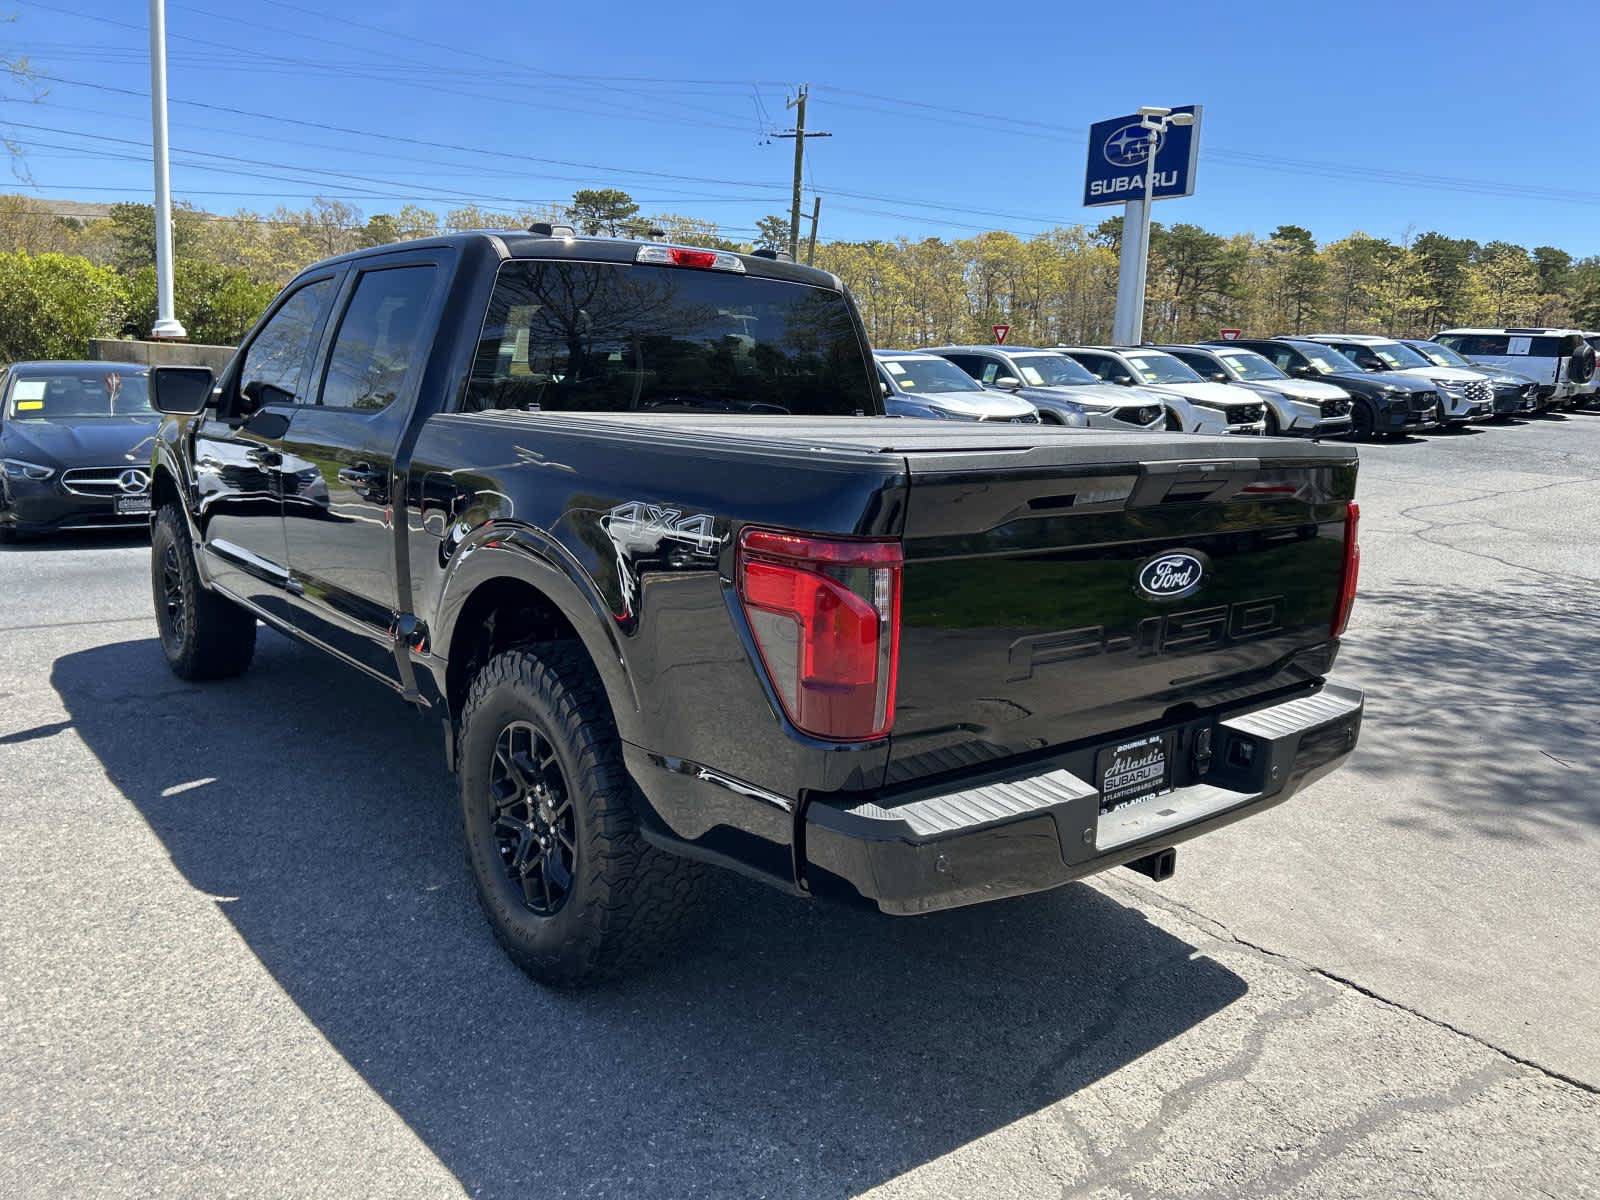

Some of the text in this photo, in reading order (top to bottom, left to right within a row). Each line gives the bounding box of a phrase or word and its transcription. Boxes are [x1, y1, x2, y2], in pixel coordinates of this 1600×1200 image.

[1090, 171, 1178, 196] SUBARU
[1150, 560, 1193, 589] Ford
[1005, 594, 1285, 683] F-150
[1104, 748, 1166, 777] Atlantic
[1104, 767, 1151, 790] SUBARU
